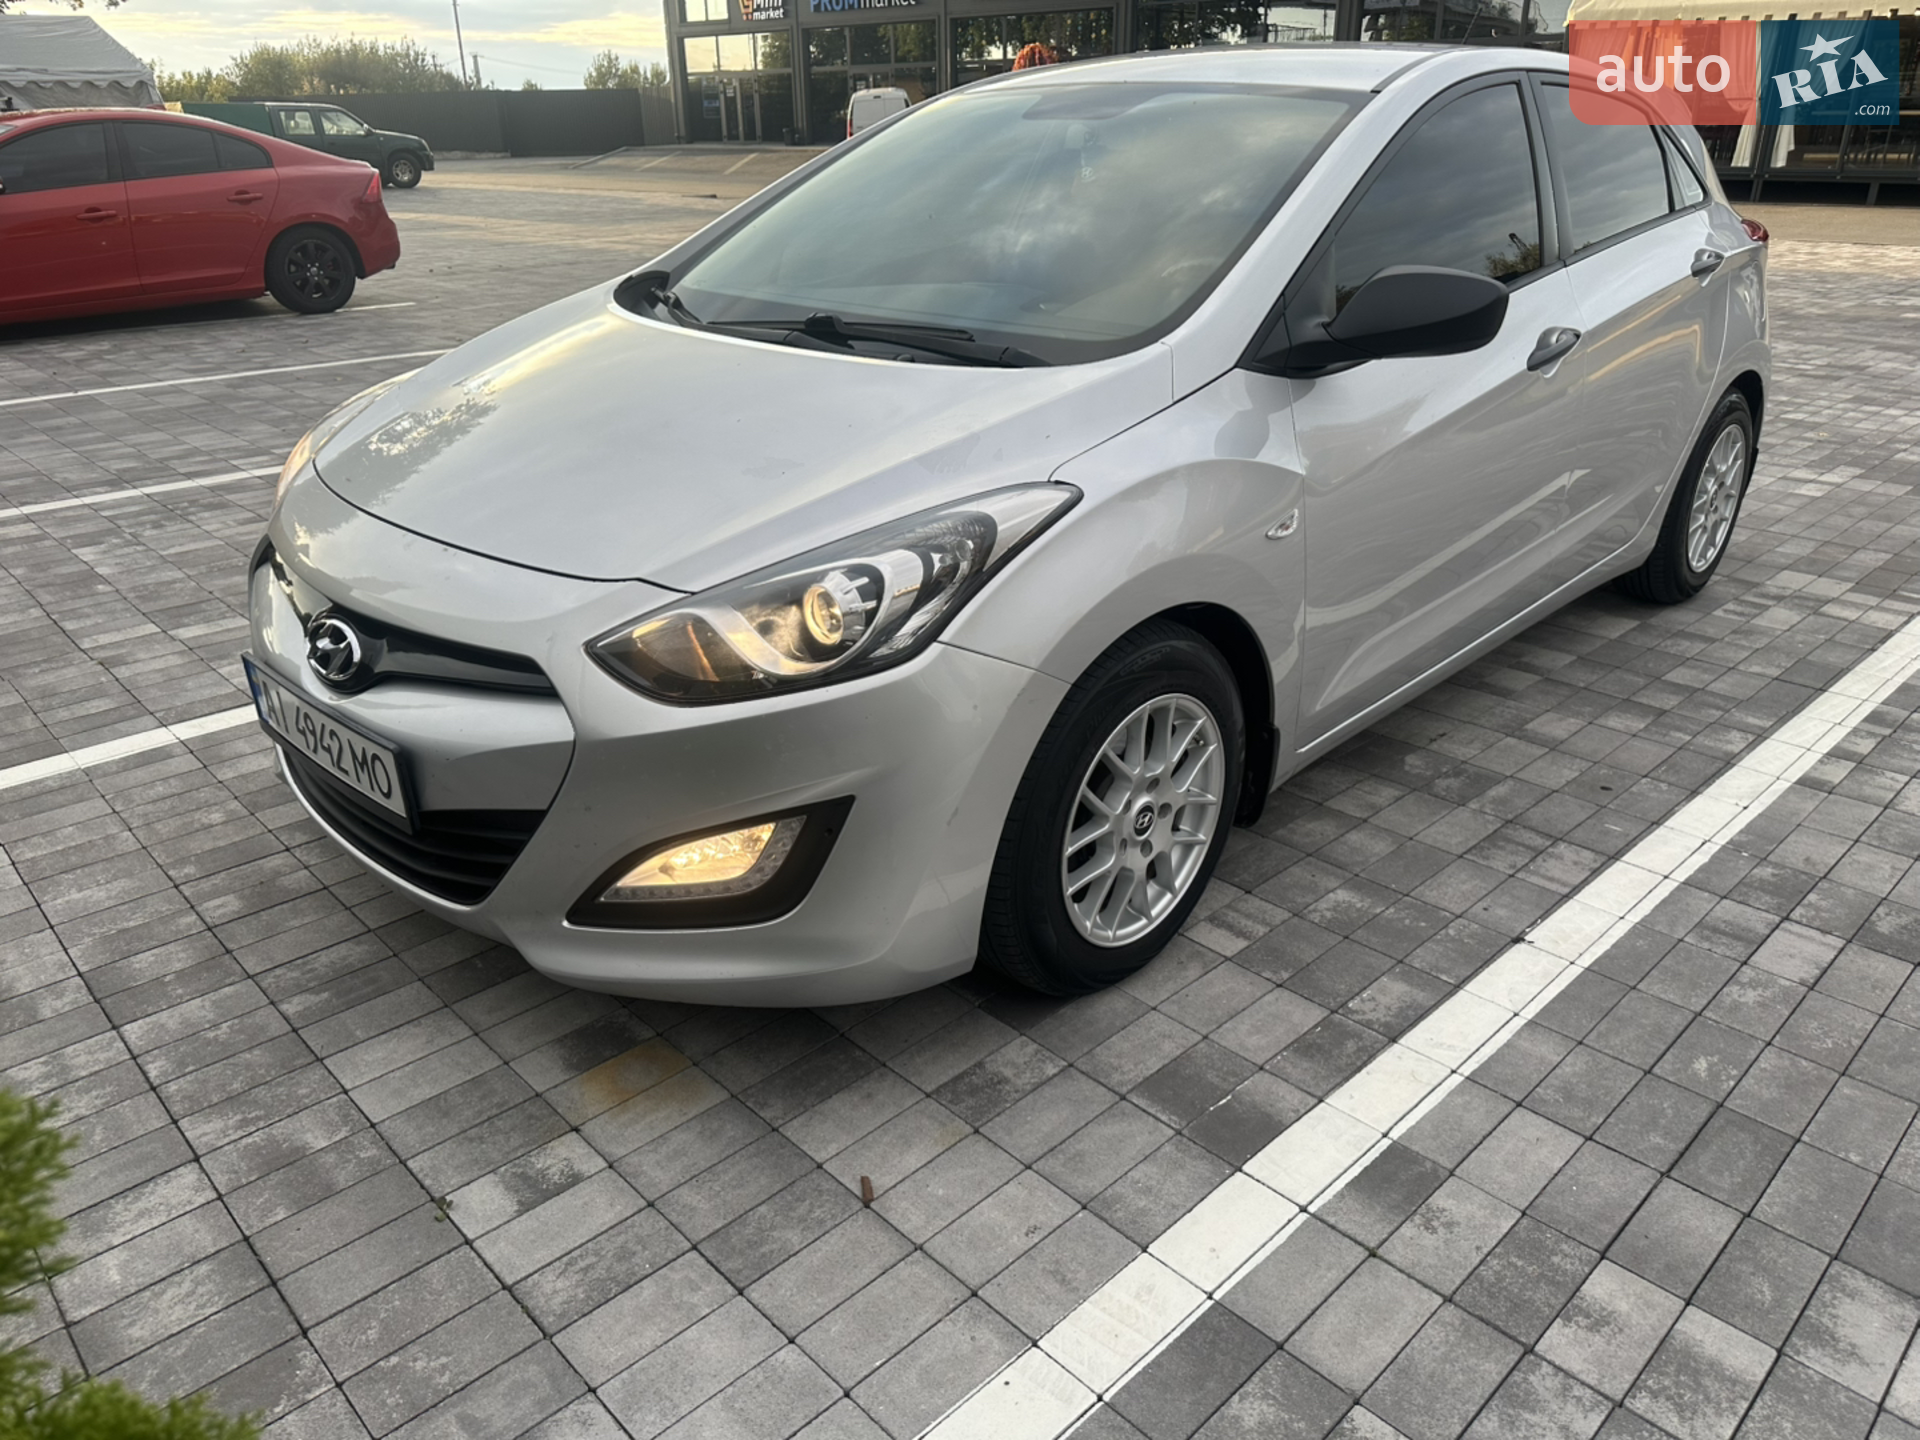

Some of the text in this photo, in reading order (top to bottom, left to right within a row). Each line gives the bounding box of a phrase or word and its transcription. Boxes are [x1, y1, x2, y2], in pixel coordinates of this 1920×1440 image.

[753, 8, 784, 20] market
[262, 680, 393, 800] AI 4942 MO
